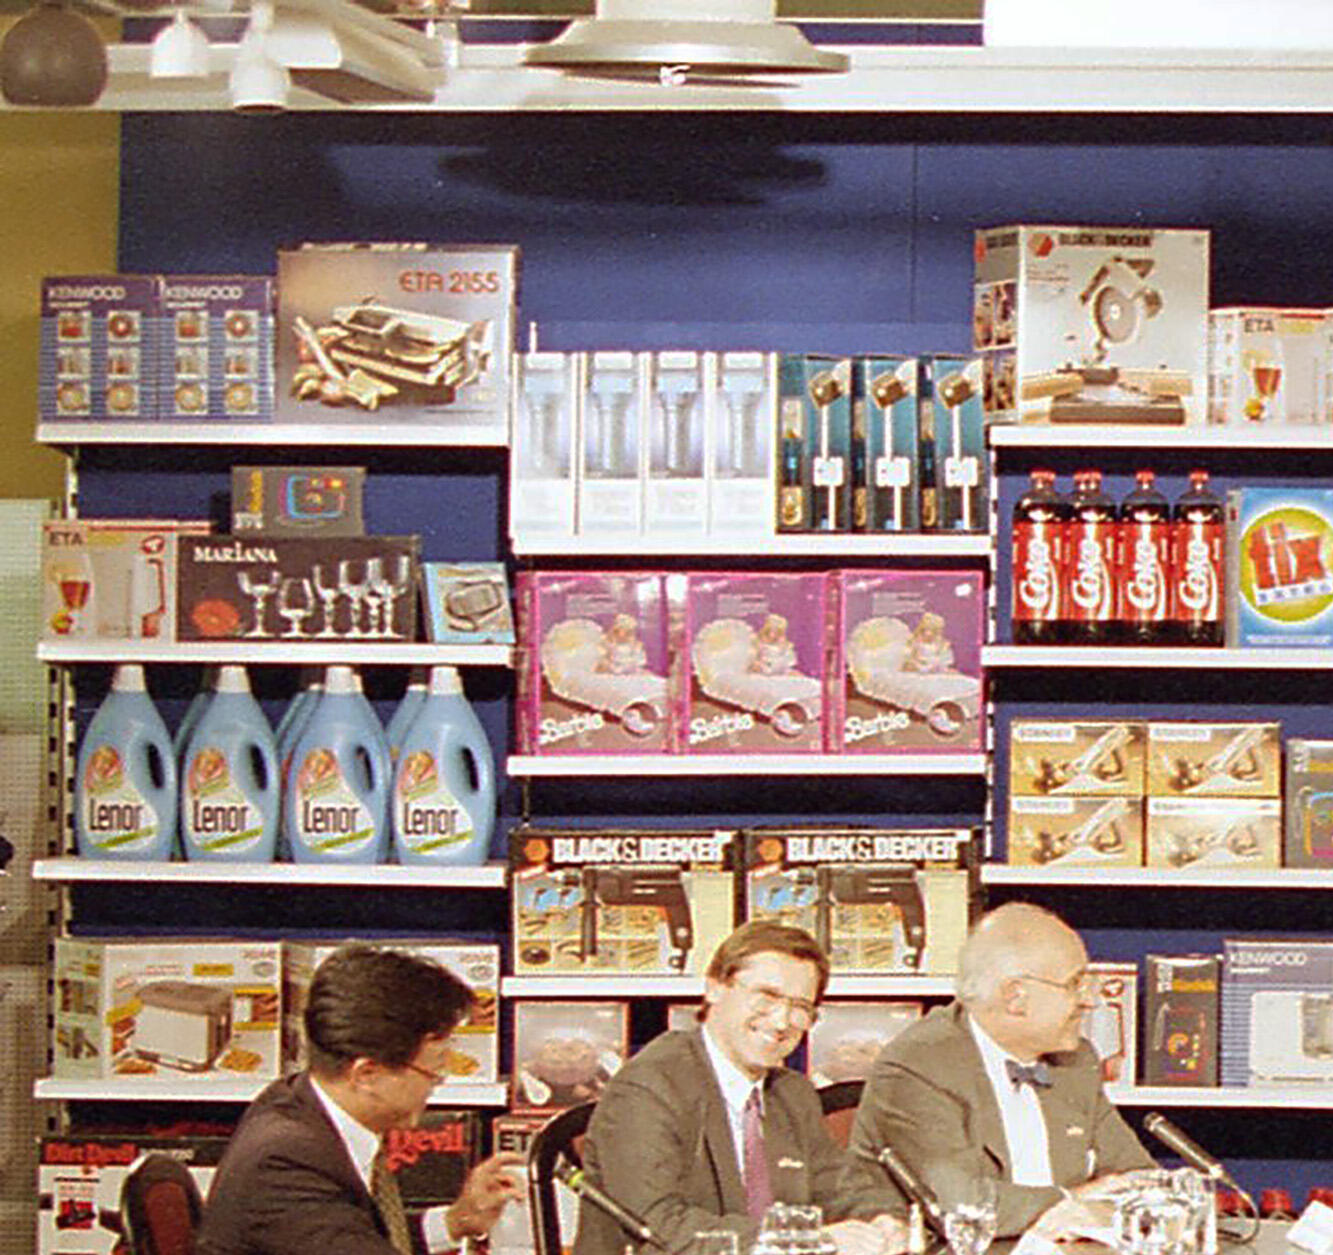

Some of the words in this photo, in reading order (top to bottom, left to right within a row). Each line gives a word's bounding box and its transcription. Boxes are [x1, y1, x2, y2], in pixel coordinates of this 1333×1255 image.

[49, 286, 126, 300] KENWOOD
[399, 271, 443, 292] ETA
[449, 271, 499, 293] 2155
[1244, 319, 1274, 333] ETA
[49, 532, 83, 546] ETA
[538, 713, 604, 745] Barbie
[689, 713, 753, 745] Barbie
[845, 712, 909, 743] Barbie
[90, 799, 142, 831] Lenor
[194, 800, 248, 832] Lenor
[303, 801, 359, 833] Lenor
[404, 803, 458, 836] Lenor
[1230, 952, 1306, 965] KENWOOD
[499, 1130, 532, 1151] ET
